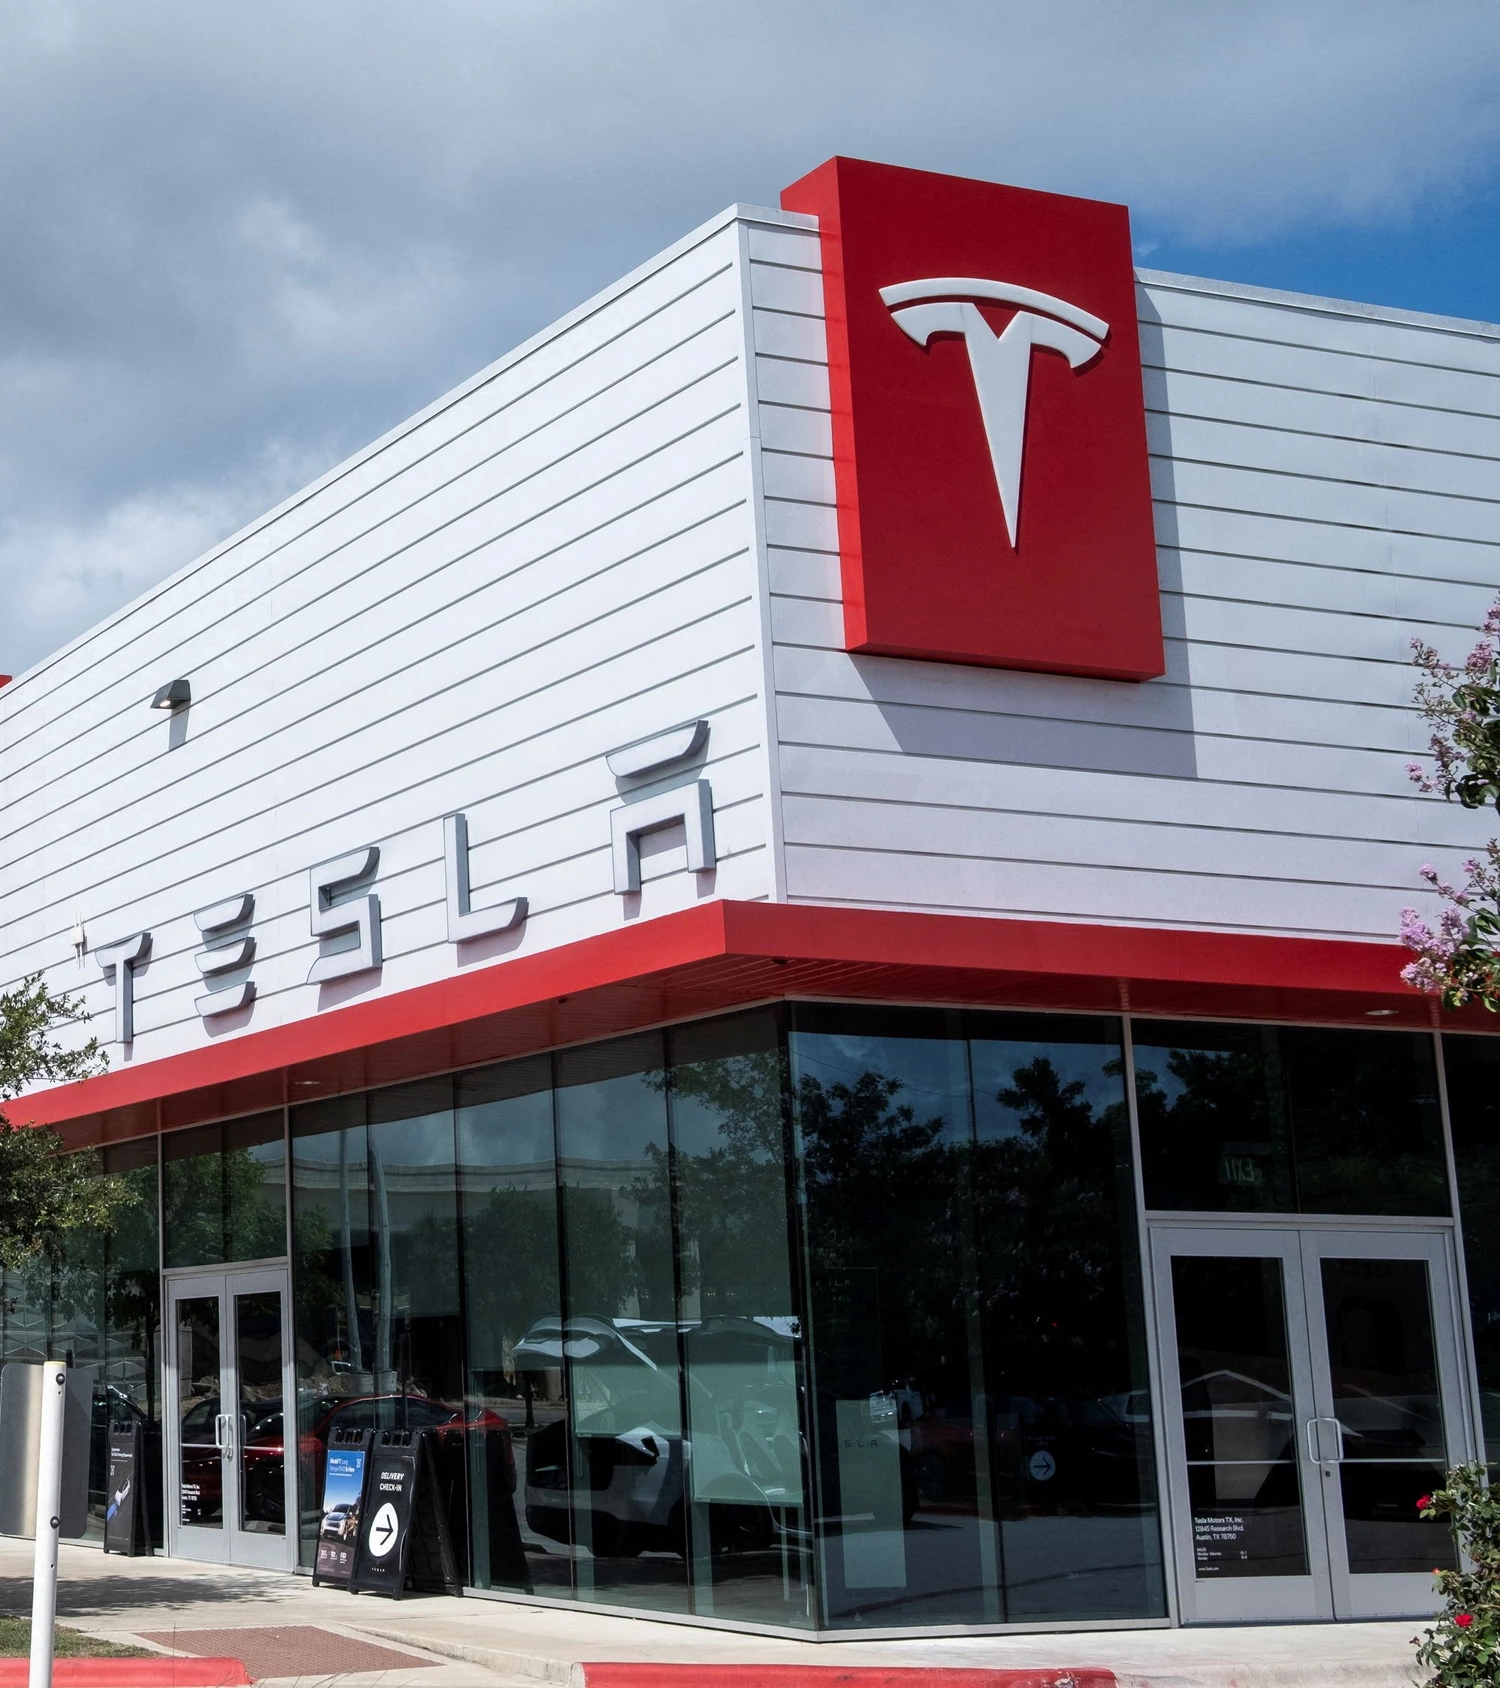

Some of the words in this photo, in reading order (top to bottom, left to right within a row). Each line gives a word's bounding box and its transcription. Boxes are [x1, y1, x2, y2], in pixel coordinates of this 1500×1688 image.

[95, 719, 717, 1045] TESLA
[380, 1472, 405, 1480] DELIVERY
[379, 1483, 402, 1491] CHECK-IN
